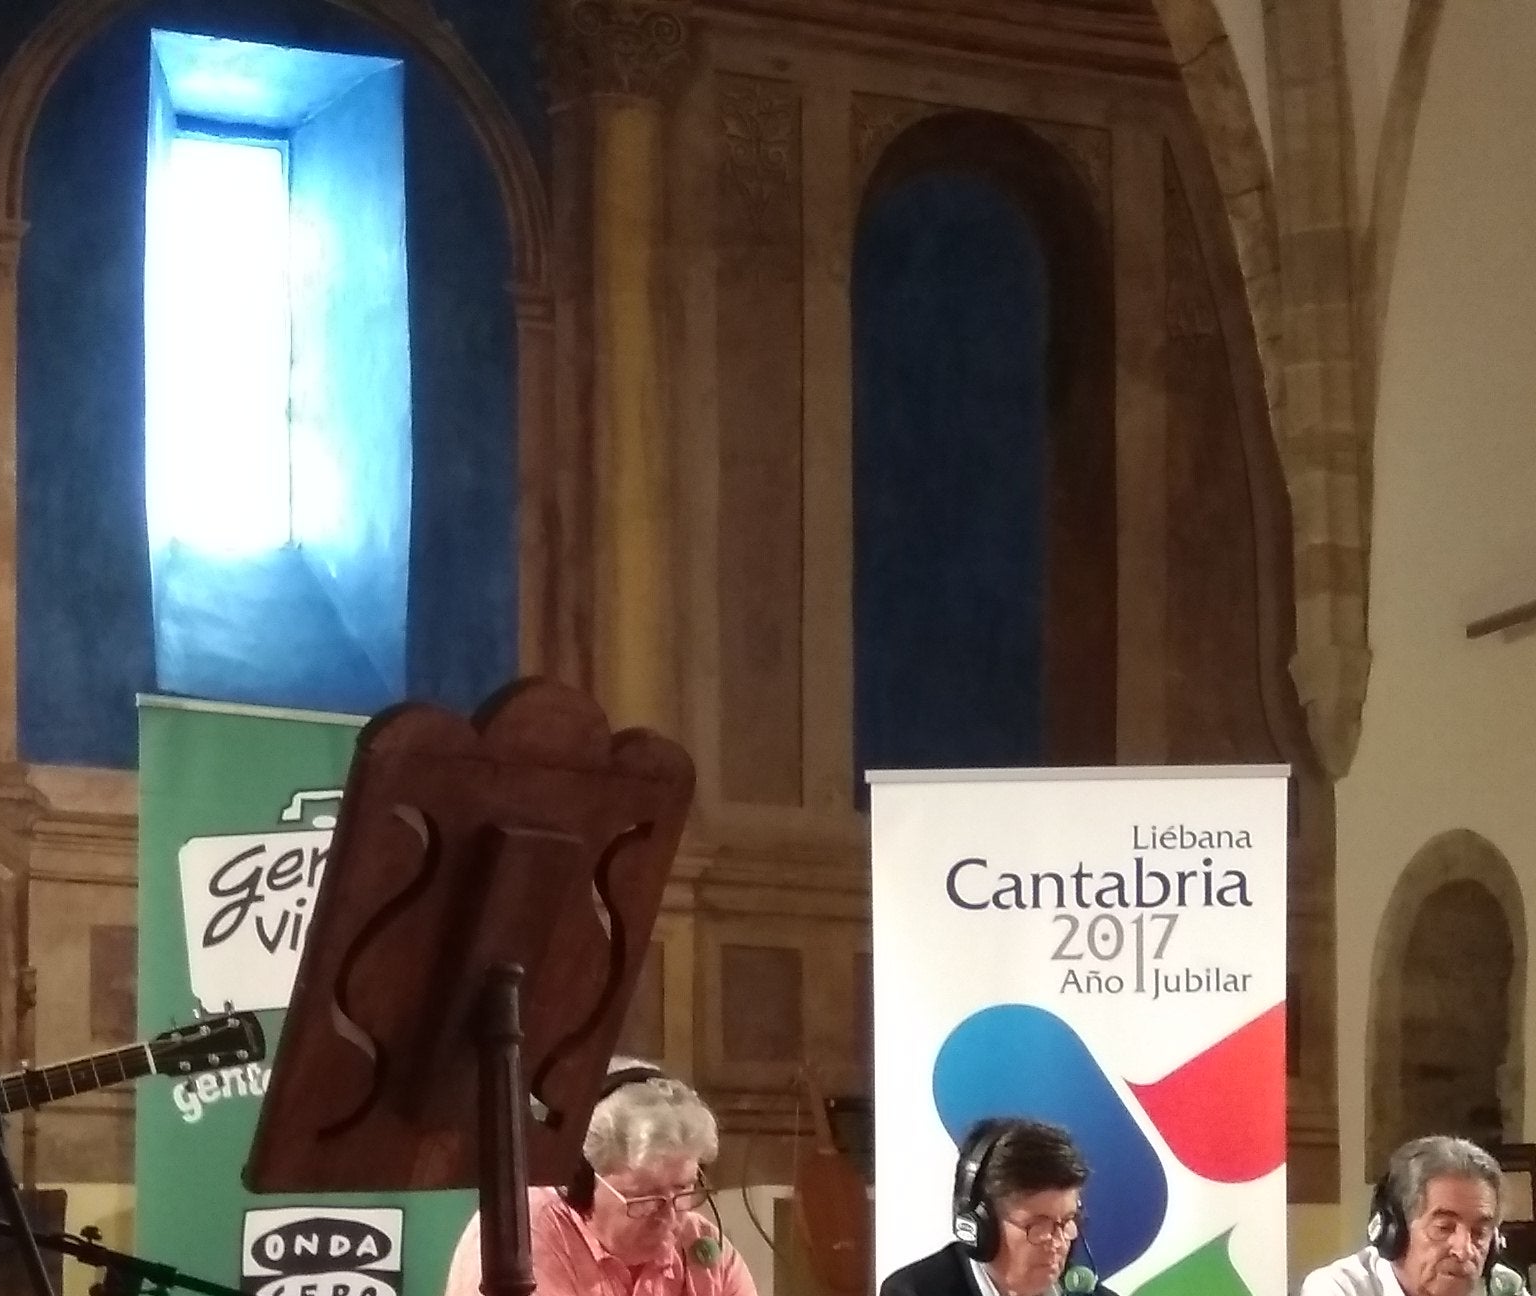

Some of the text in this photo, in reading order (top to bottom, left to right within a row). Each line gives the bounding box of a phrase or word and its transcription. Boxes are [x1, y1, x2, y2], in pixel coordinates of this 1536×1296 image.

[1133, 825, 1252, 850] Liébana
[946, 857, 1253, 910] Cantabria
[1050, 913, 1179, 993] 2017
[1060, 967, 1252, 1000] Año Jubilar
[173, 1062, 271, 1123] gent
[265, 1233, 378, 1261] ONDA
